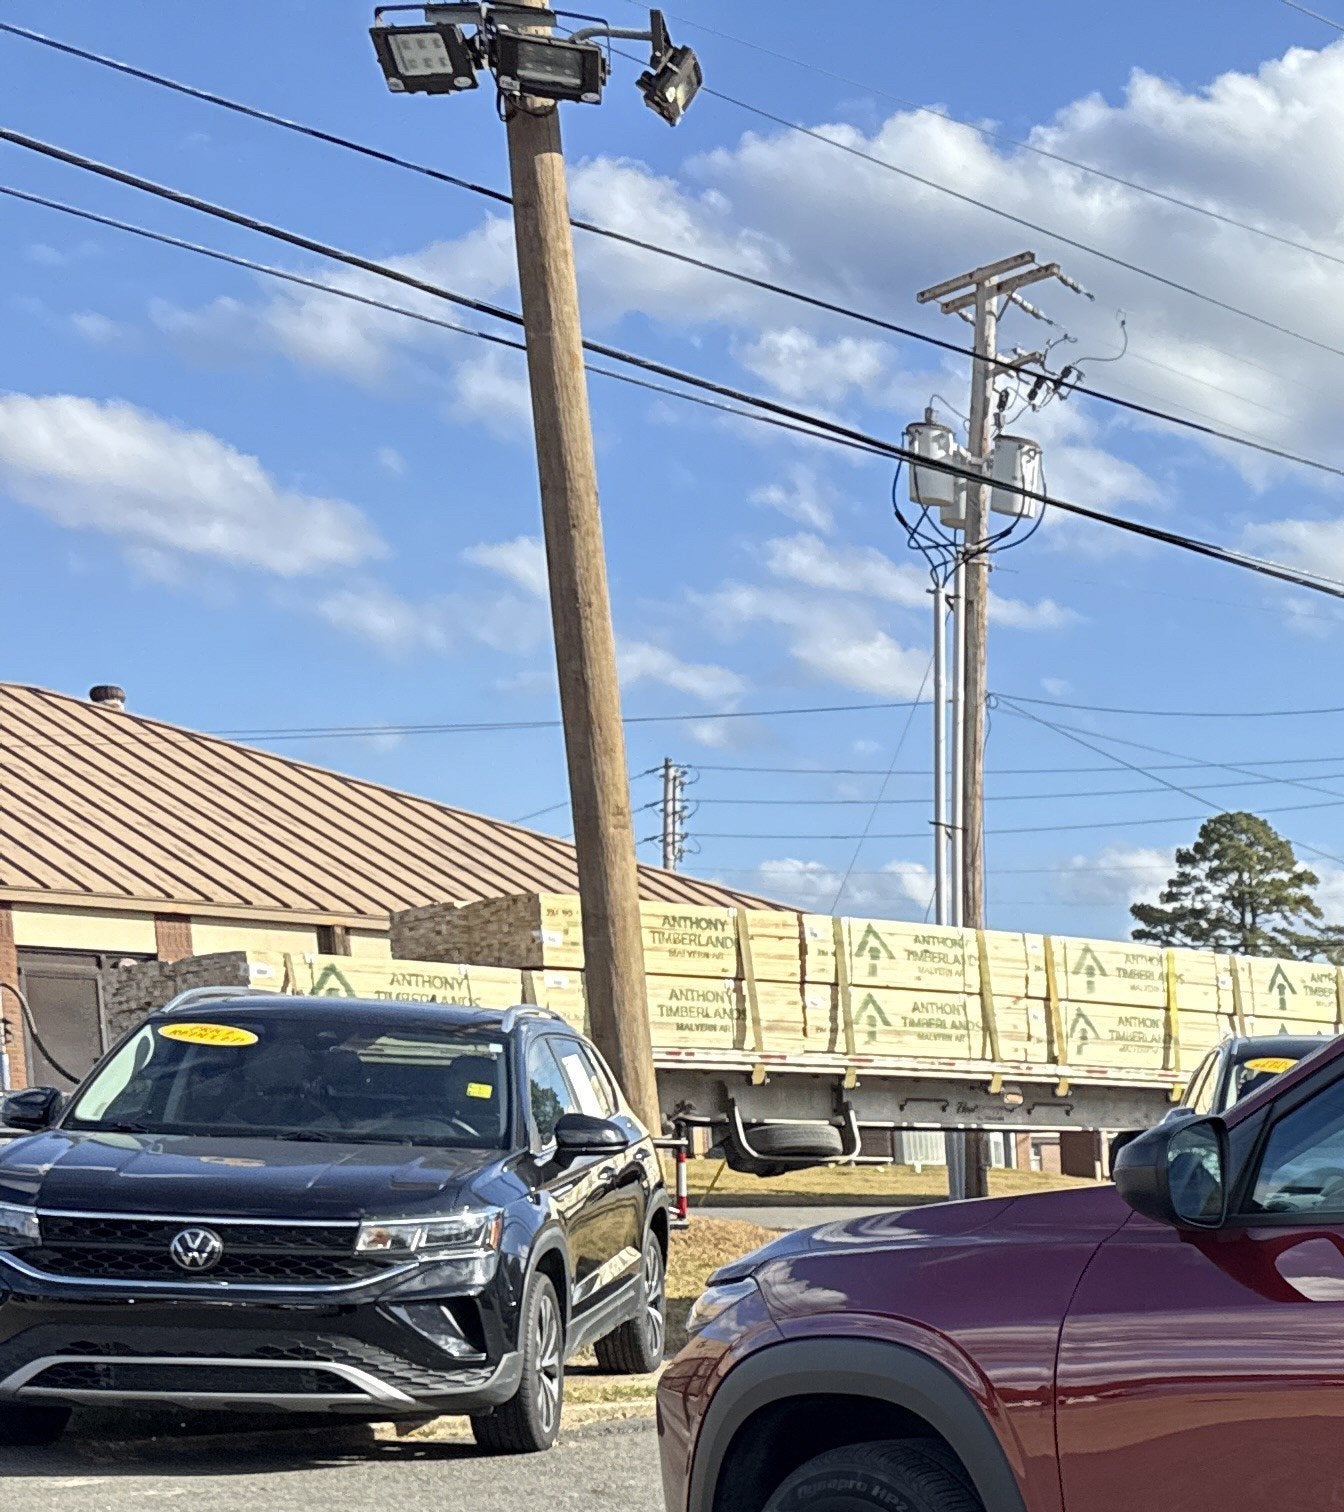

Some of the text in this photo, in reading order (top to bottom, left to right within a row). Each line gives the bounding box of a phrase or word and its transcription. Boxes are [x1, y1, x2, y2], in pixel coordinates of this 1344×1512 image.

[662, 915, 729, 932] ANTHONY
[649, 930, 742, 949] TIMBERLAND
[389, 972, 464, 991] ANTHONY
[668, 988, 734, 1003] ANTHONY
